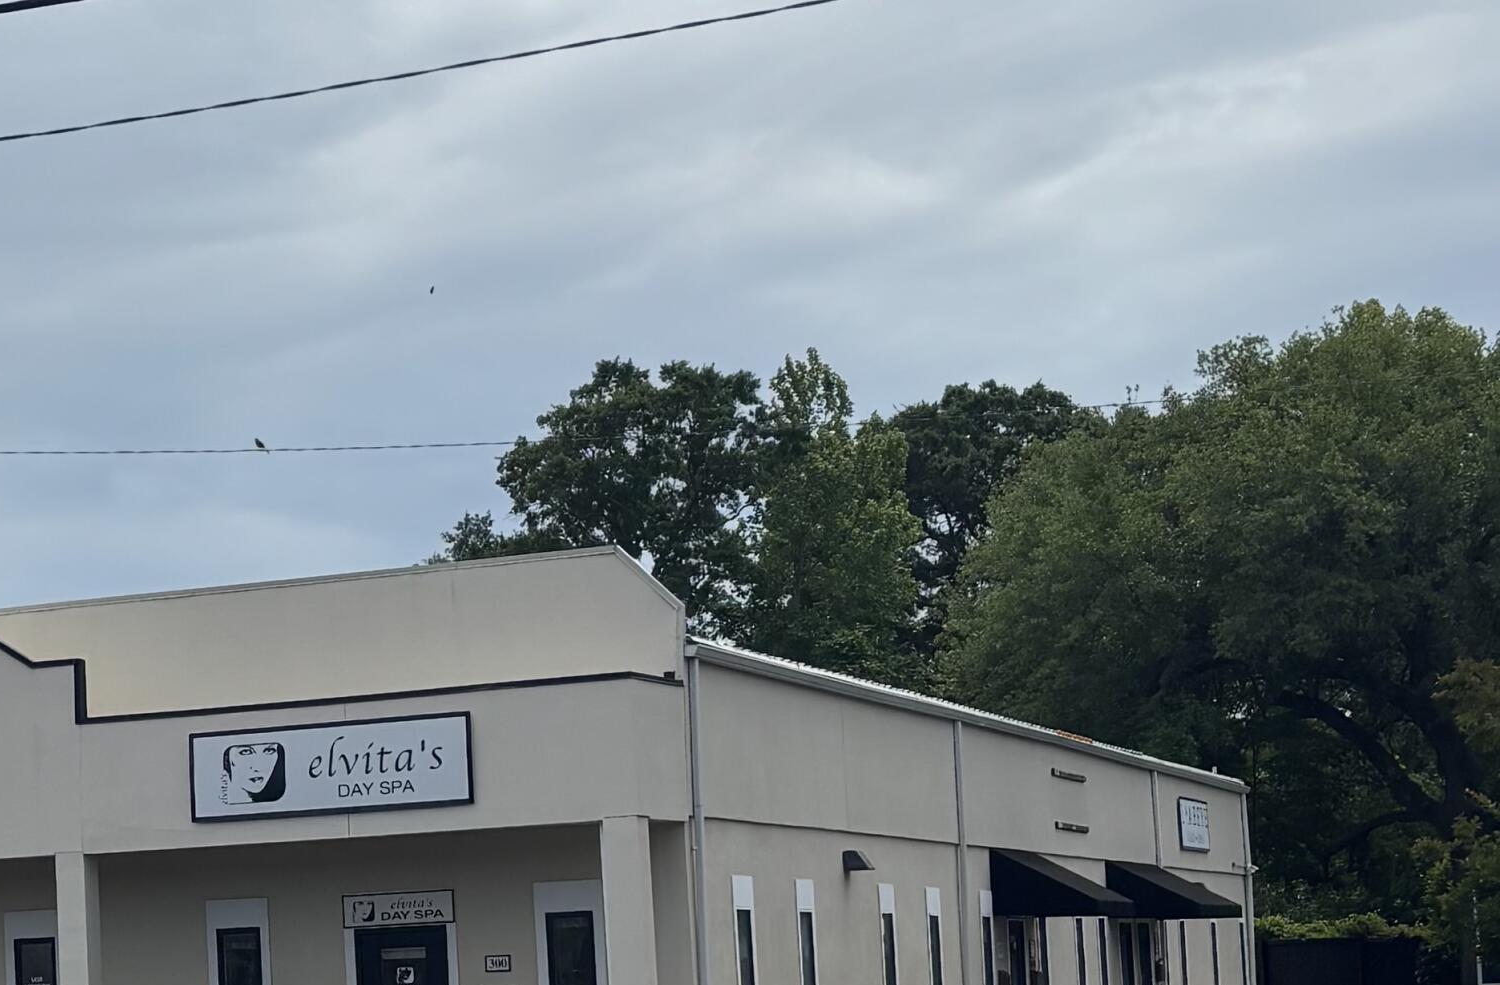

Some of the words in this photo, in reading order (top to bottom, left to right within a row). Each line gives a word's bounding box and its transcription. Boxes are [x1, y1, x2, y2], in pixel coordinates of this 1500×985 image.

[308, 736, 444, 779] elvita's
[338, 783, 373, 798] DAY
[379, 780, 415, 796] SPA
[390, 897, 434, 910] elvita's
[381, 910, 410, 921] DAY
[414, 909, 445, 919] SPA
[488, 957, 508, 969] 300
